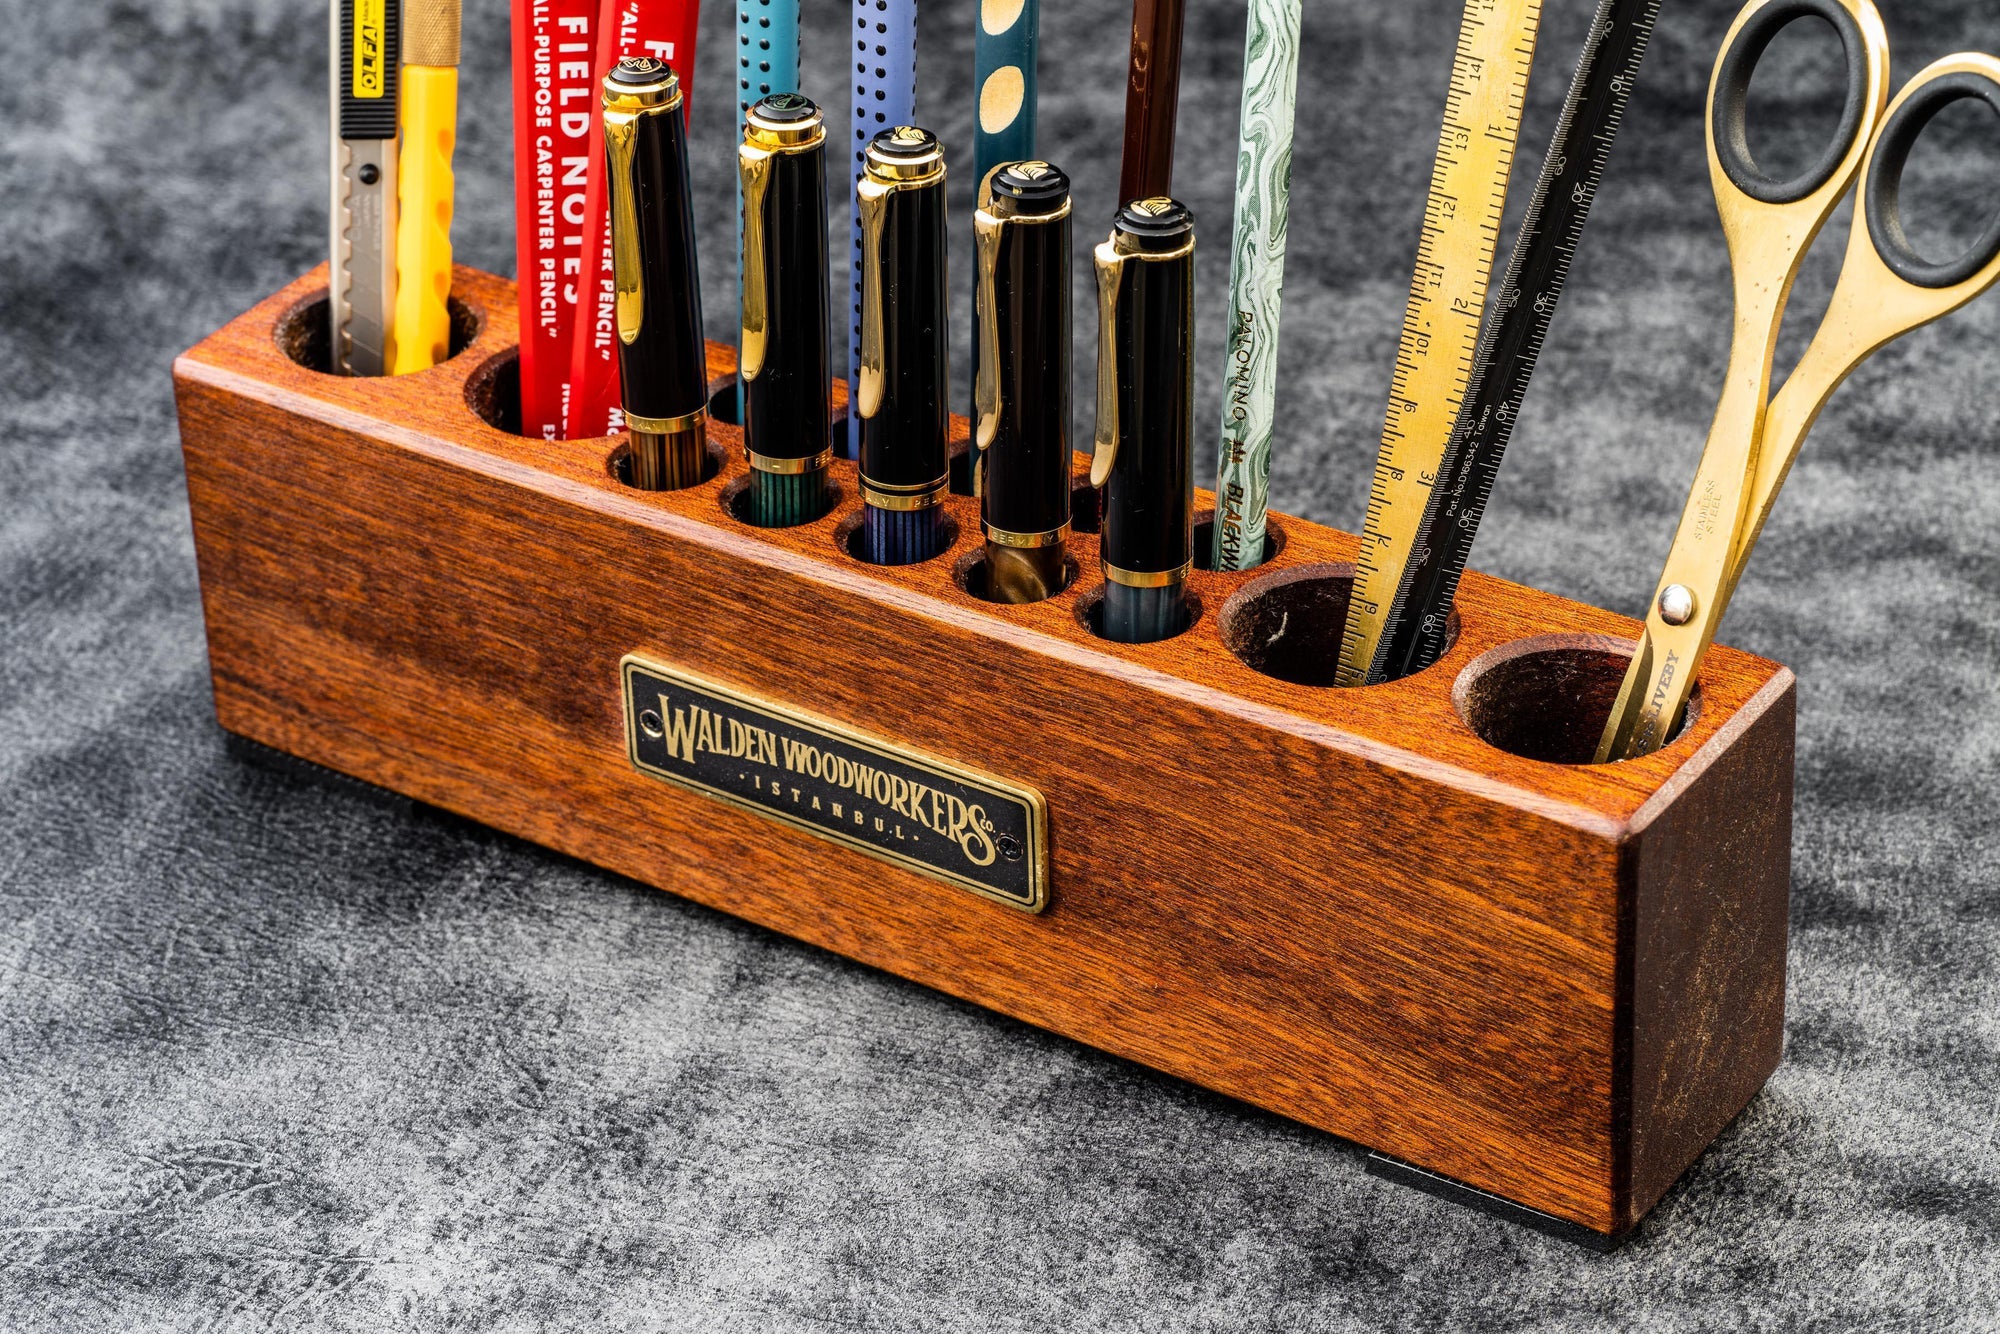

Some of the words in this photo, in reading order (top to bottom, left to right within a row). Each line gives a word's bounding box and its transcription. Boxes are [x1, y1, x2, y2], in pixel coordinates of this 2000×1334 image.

[361, 25, 377, 90] OLFA
[558, 16, 589, 138] FIELD
[1469, 63, 1482, 81] 14
[1610, 74, 1625, 92] 10
[1456, 132, 1469, 150] 13
[1554, 156, 1567, 176] 60
[536, 135, 554, 250] CARPENTER
[1572, 182, 1586, 203] 20
[1443, 201, 1456, 220] 12
[1429, 270, 1443, 288] 11
[1454, 298, 1468, 309] 2
[1533, 292, 1549, 312] 30
[1416, 338, 1430, 357] 10
[1232, 310, 1253, 419] PALOMINO
[1474, 404, 1492, 436] Taiwan
[1496, 401, 1510, 421] 40
[1464, 419, 1476, 439] 40
[1391, 471, 1403, 481] 8
[1420, 470, 1435, 482] 3
[1459, 508, 1474, 528] 50
[1694, 478, 1717, 541] STAINLESS
[1705, 493, 1722, 535] STEEL
[1417, 547, 1431, 566] 30
[1364, 605, 1377, 615] 6
[1422, 614, 1436, 633] 60
[658, 693, 778, 767] WALDEN
[781, 736, 996, 867] WOODWORKERS
[755, 774, 905, 841] ISTANBUL
